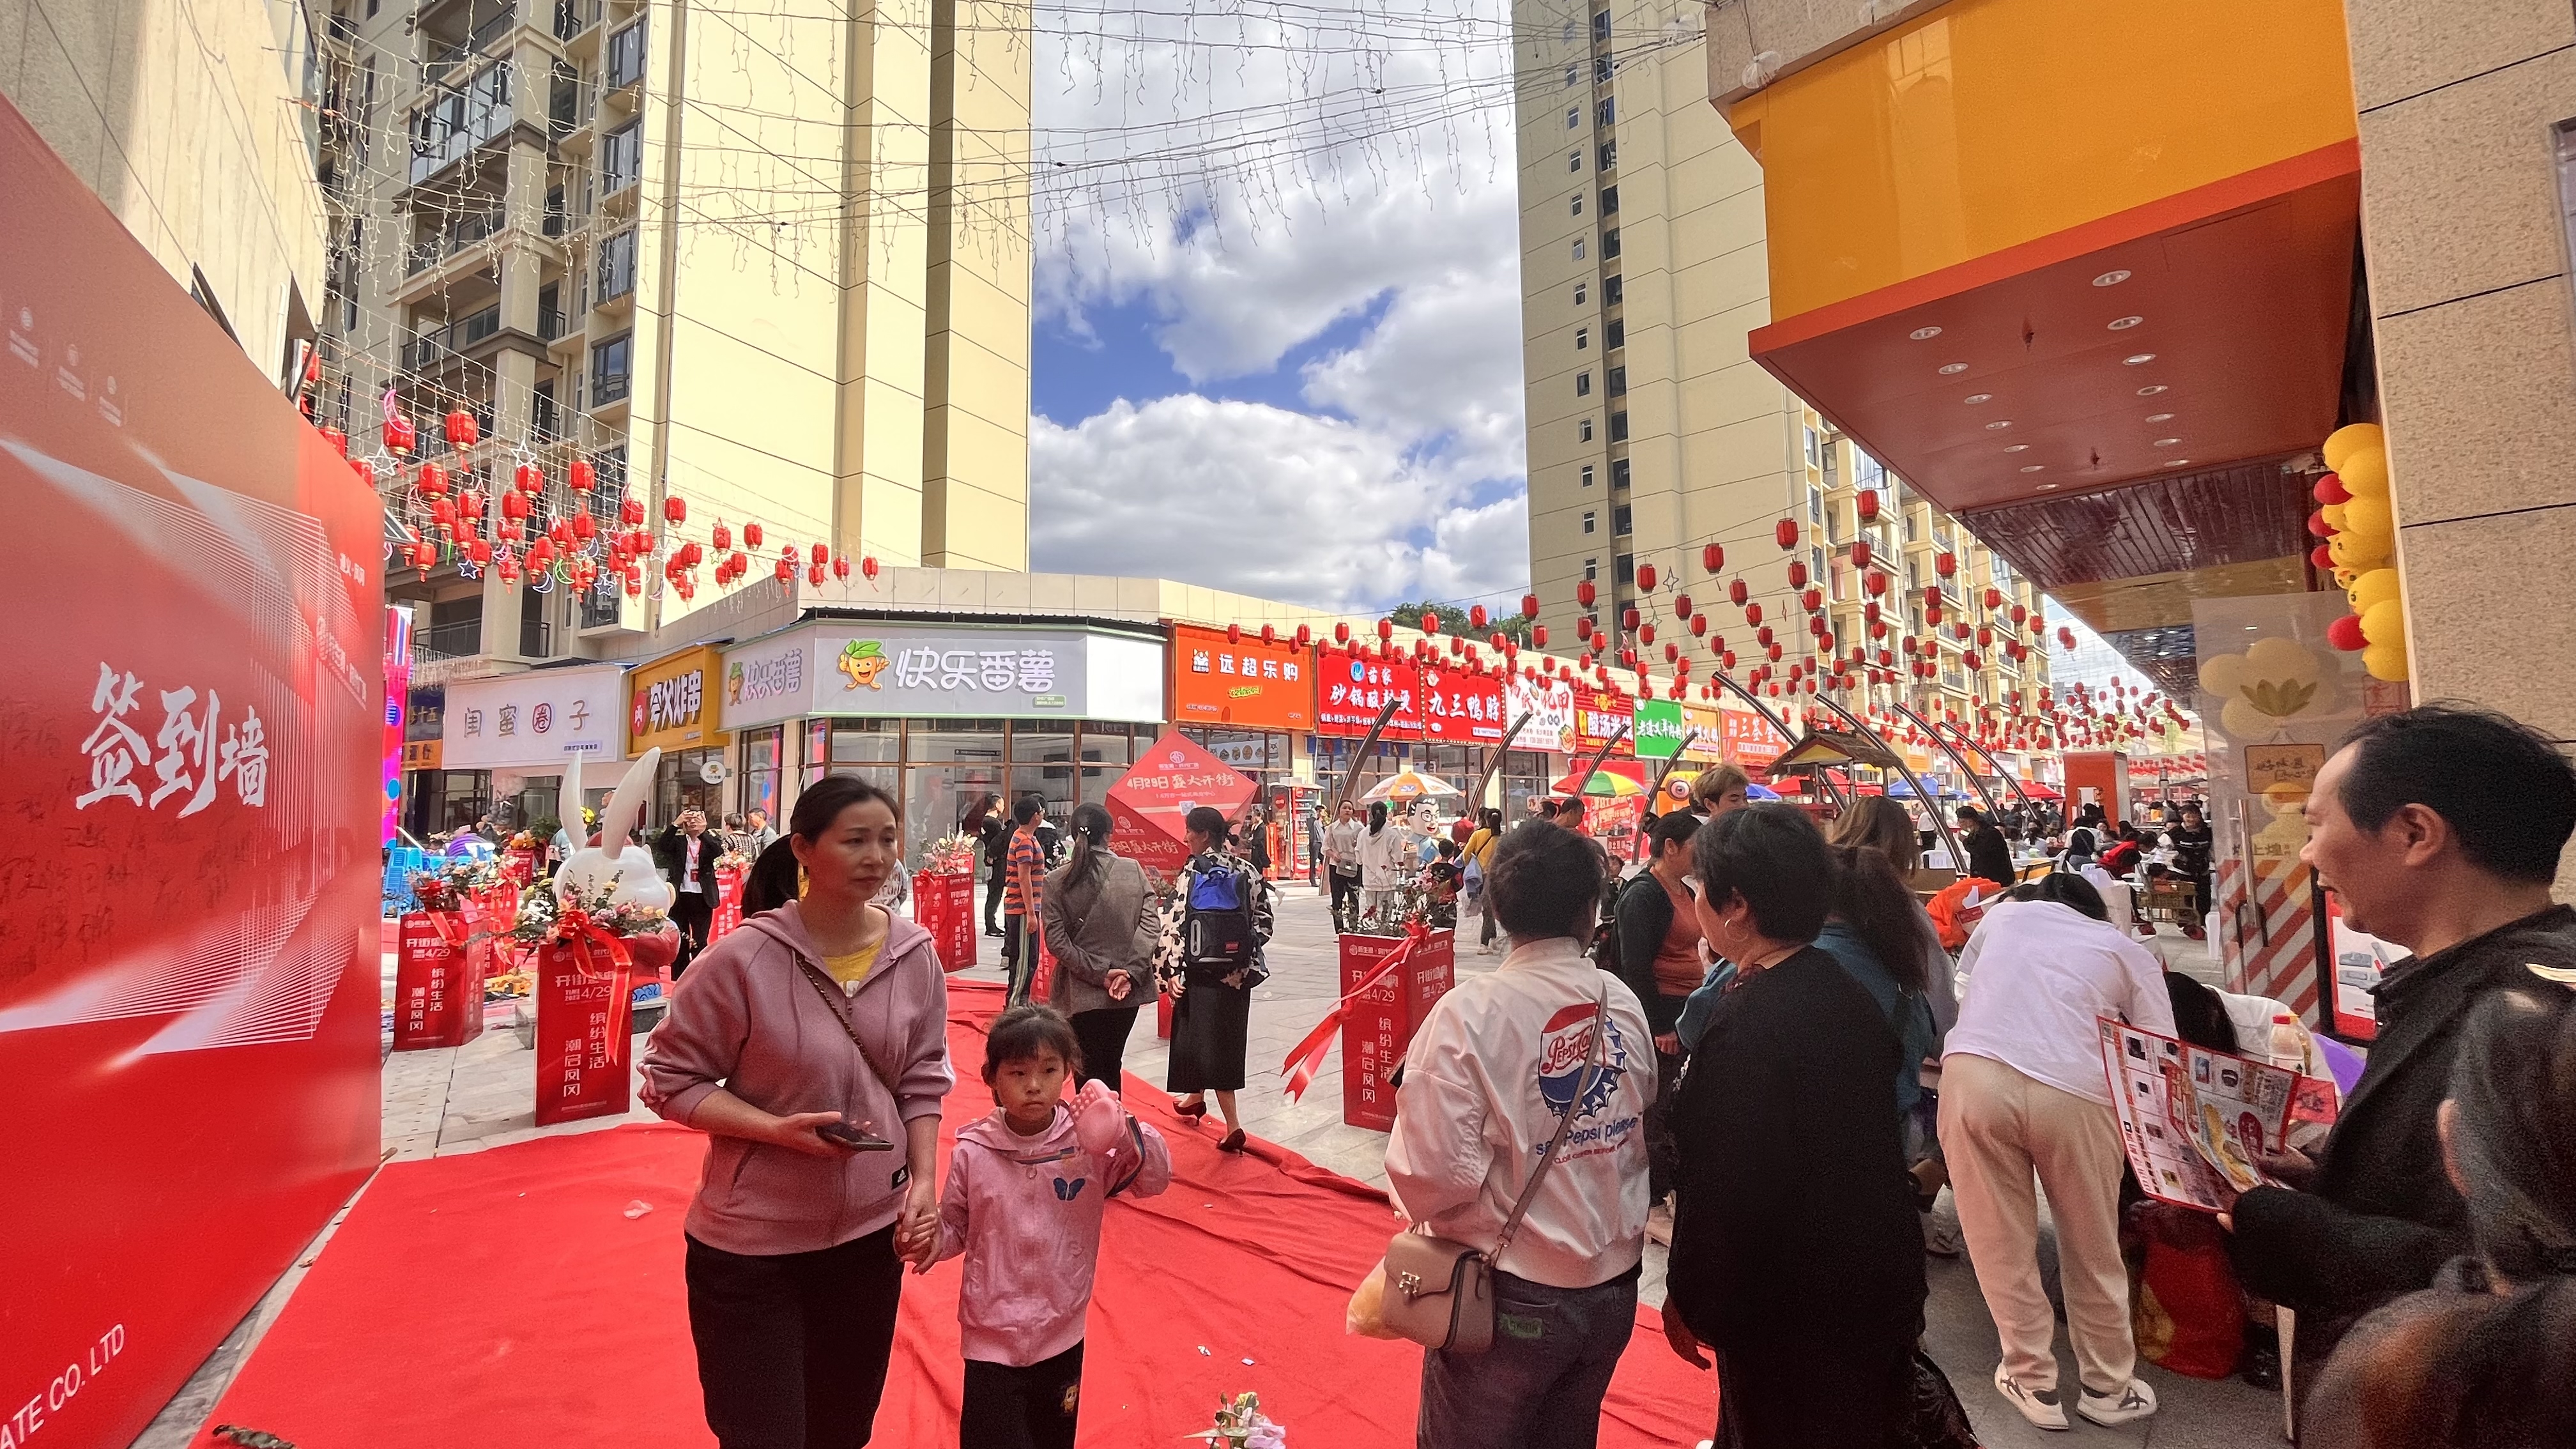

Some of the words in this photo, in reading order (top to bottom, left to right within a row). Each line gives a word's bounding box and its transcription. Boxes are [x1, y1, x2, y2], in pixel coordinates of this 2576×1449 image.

[745, 648, 802, 701] 快乐番薯
[896, 645, 1056, 694] 快乐番薯
[1219, 653, 1298, 682] 远超乐购
[463, 700, 590, 739] 闺蜜圈子
[650, 670, 702, 732] 夸父炸串
[1428, 691, 1499, 722] 九三鸭脖
[76, 661, 270, 818] 签到墙
[1172, 772, 1235, 790] 盛大开街
[425, 948, 450, 958] 4/29
[429, 968, 445, 1012] 缤纷生活
[581, 986, 612, 1000] 4/29
[1371, 989, 1395, 1002] 4/29
[588, 1012, 606, 1070] 缤纷生活
[1379, 1017, 1393, 1079] 缤纷生活
[1361, 1040, 1376, 1103] 潮启凤冈
[89, 1323, 125, 1376] LTD
